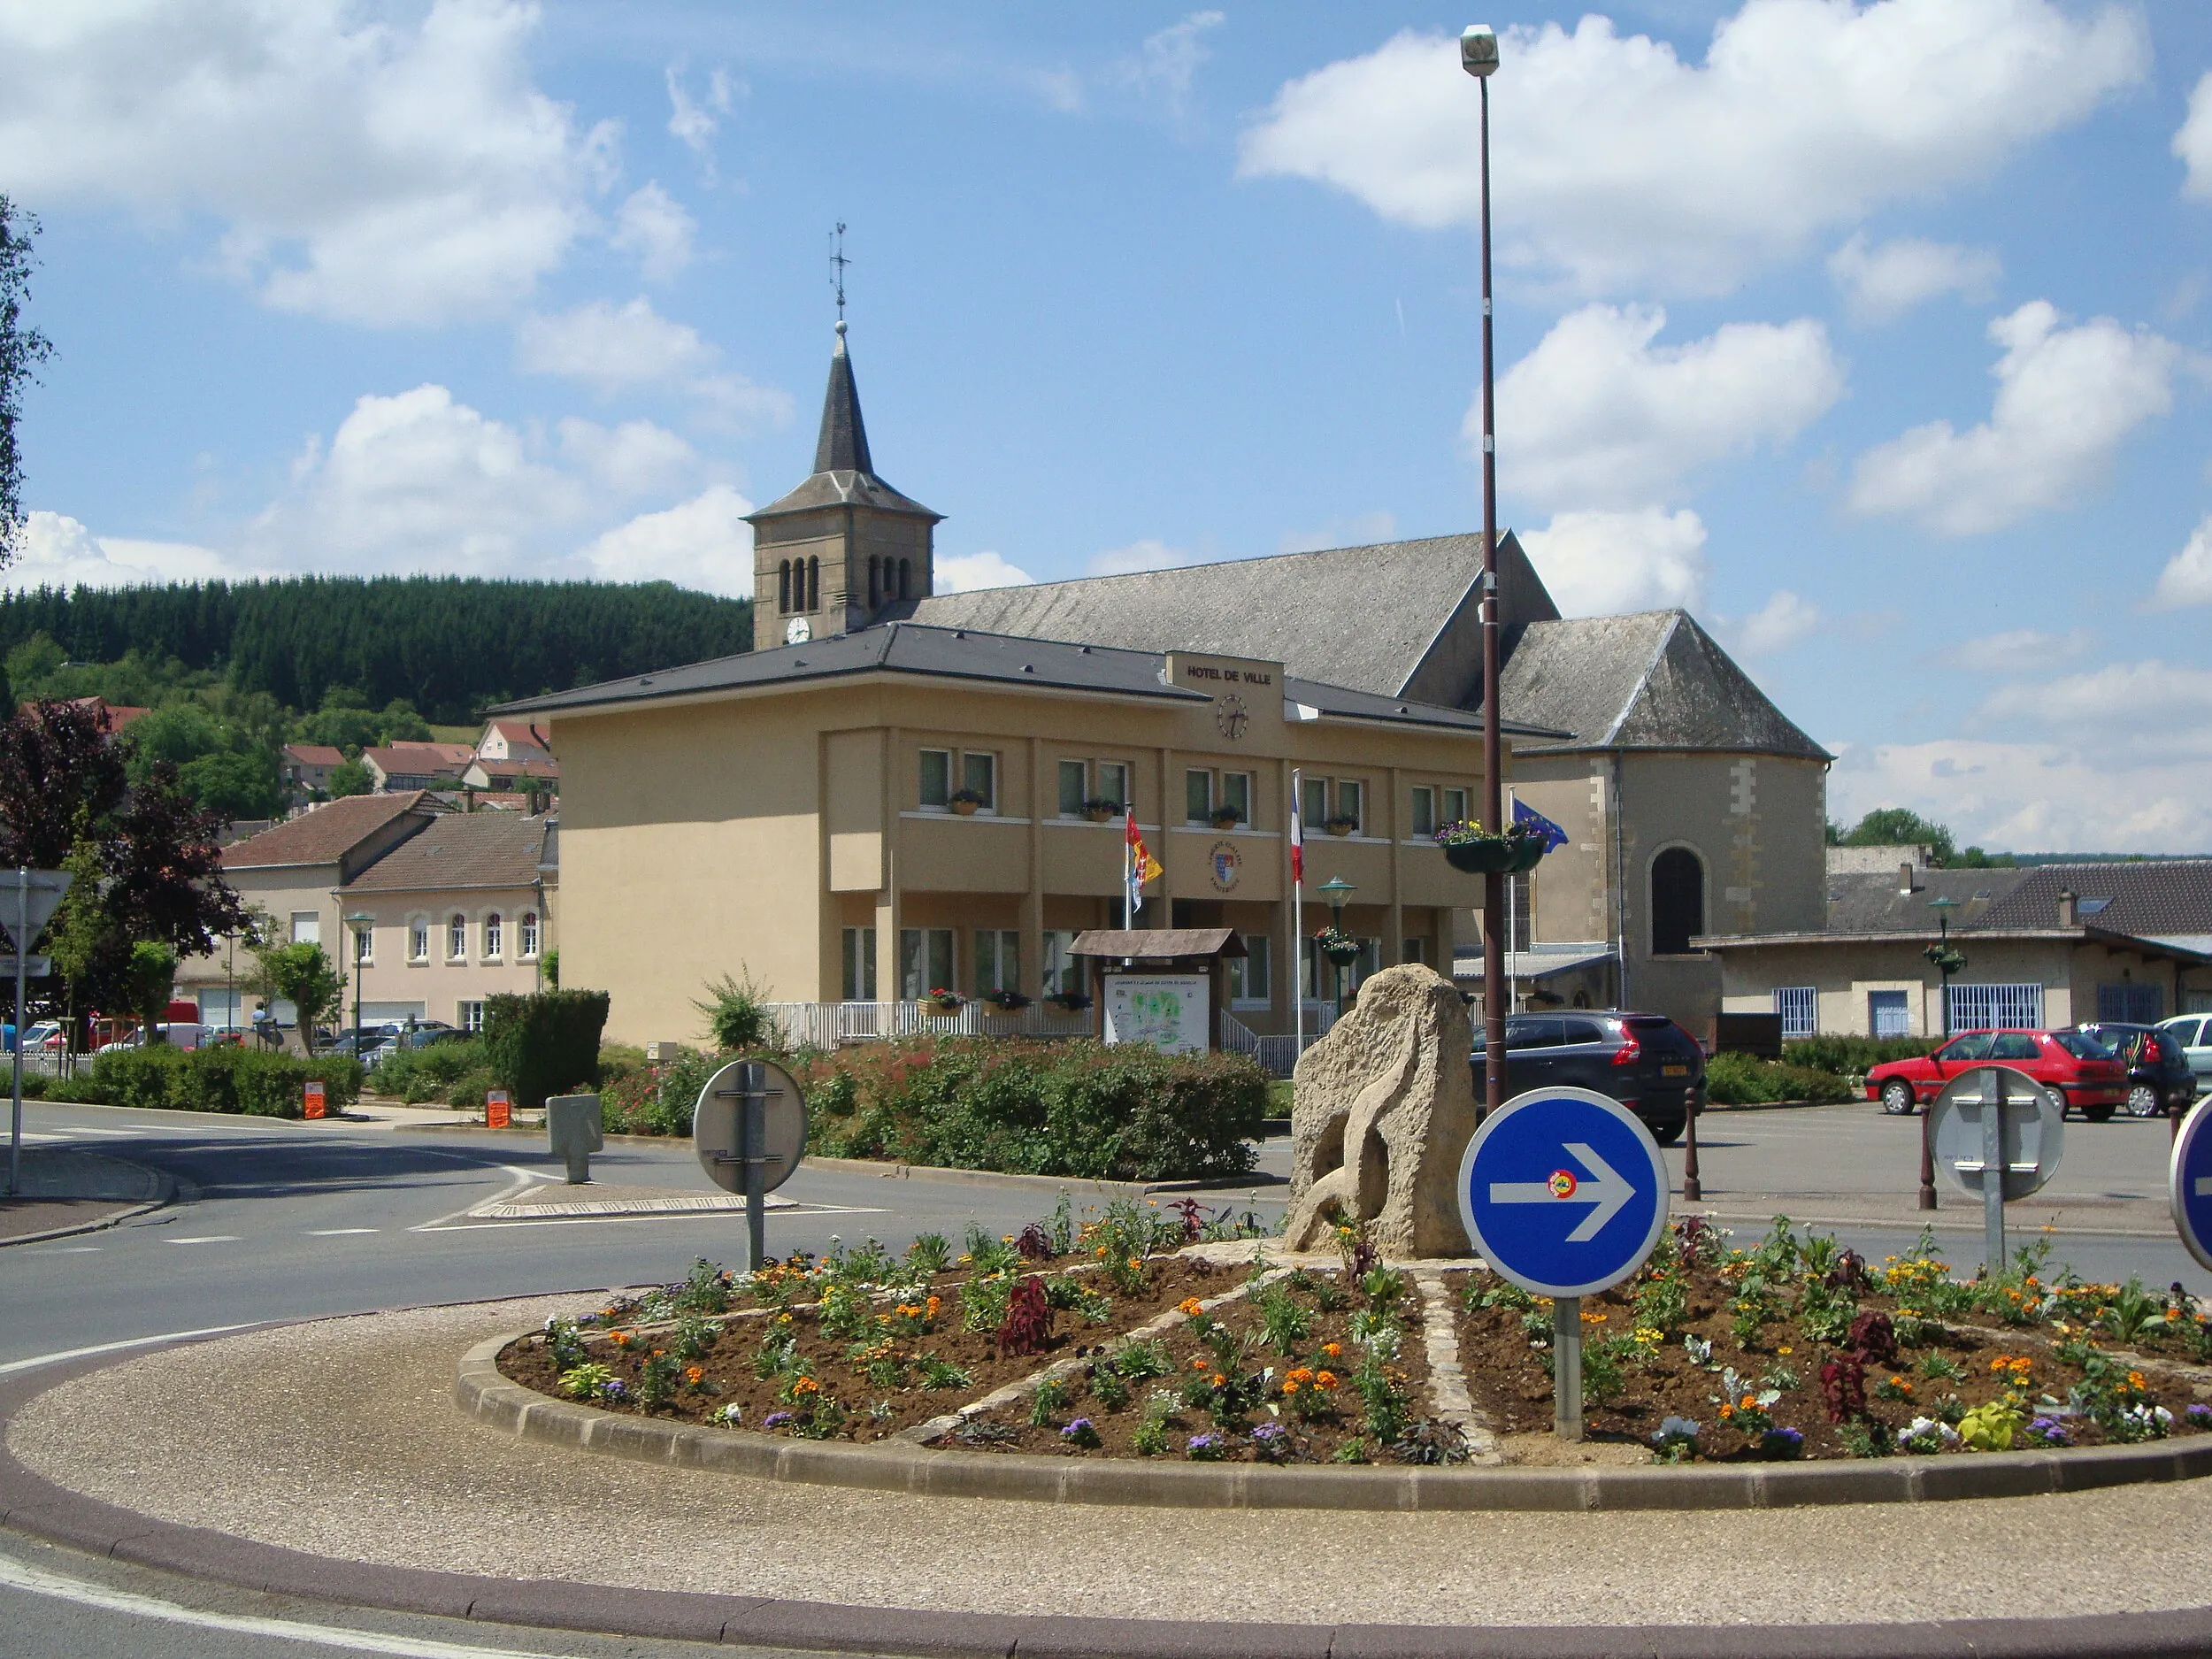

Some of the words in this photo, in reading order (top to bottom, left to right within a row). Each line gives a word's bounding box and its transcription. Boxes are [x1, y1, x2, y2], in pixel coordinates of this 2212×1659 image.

[1187, 665, 1221, 680] HOTEL
[1224, 670, 1239, 681] DE
[1244, 672, 1271, 685] VILLE
